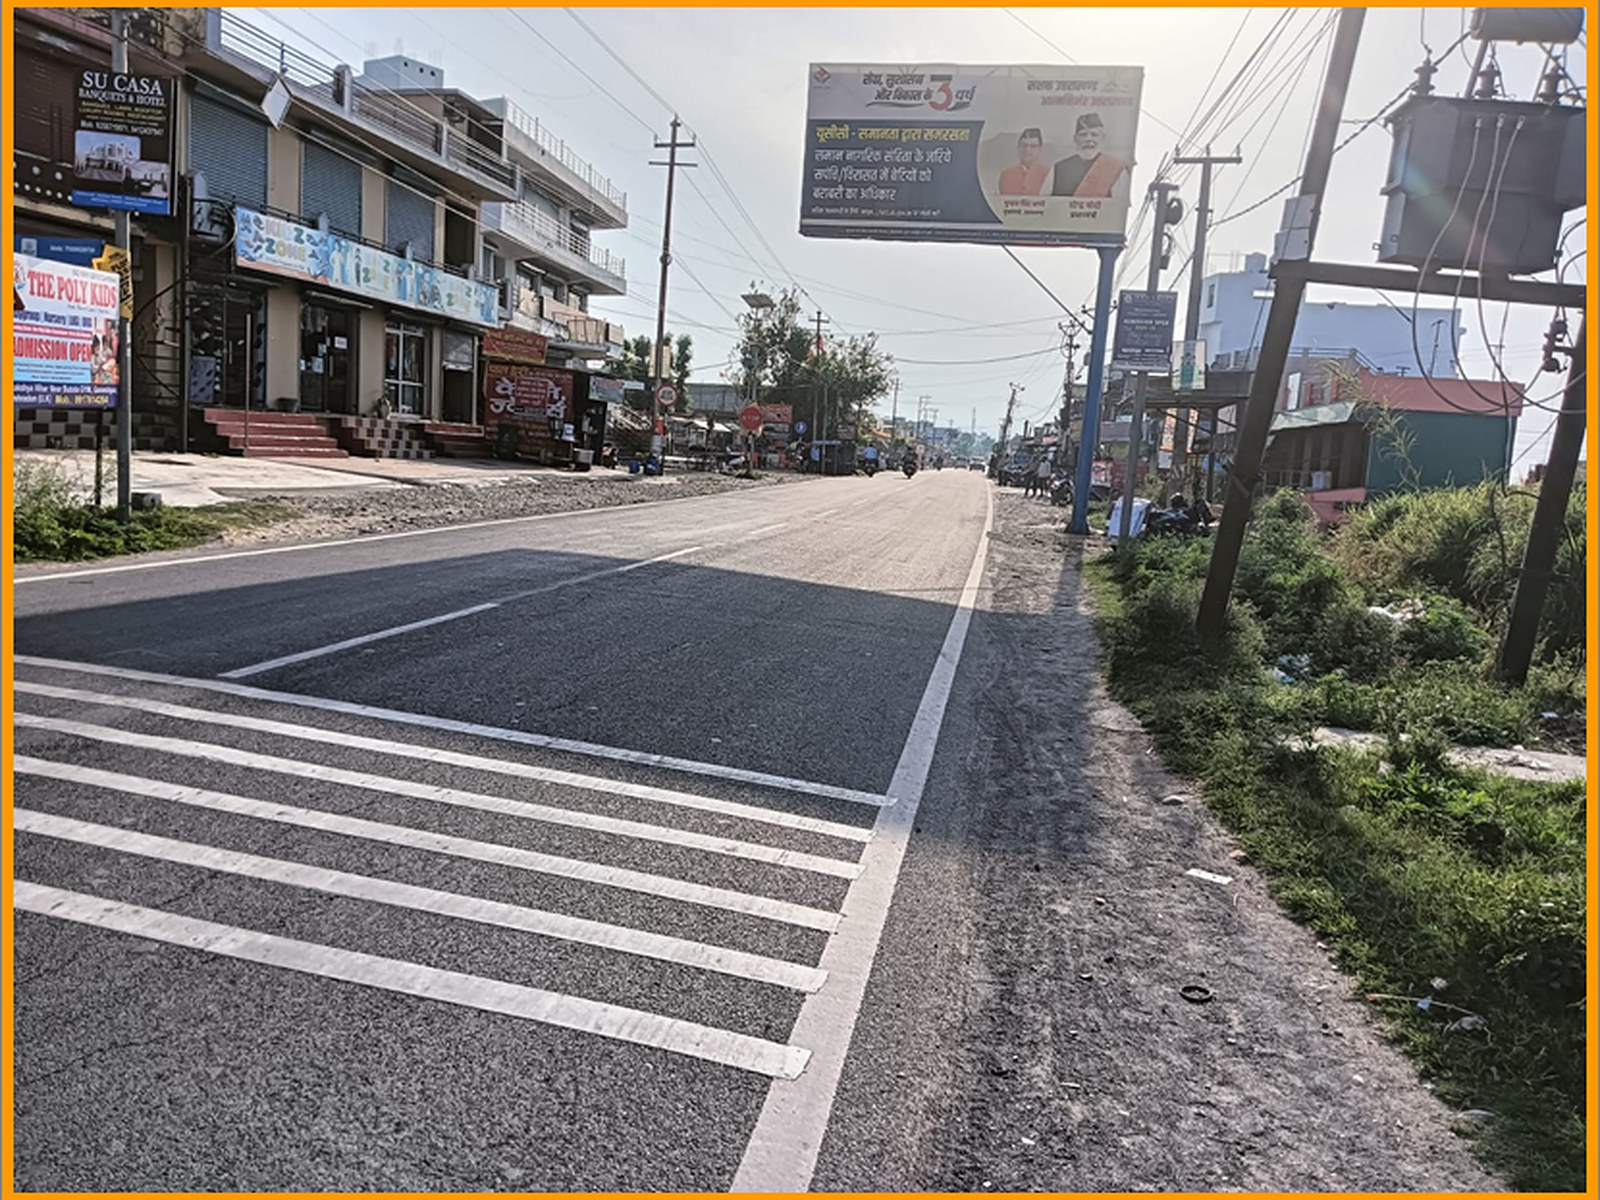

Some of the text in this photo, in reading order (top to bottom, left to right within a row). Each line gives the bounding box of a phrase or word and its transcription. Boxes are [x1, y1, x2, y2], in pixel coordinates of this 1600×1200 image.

[83, 70, 163, 96] SU CASA
[886, 73, 925, 88] सुशासन
[79, 87, 167, 107] BANQUETS & HOTEL
[874, 74, 976, 111] और विकास के 3 वर्ष
[815, 124, 849, 143] यूसीसी
[858, 127, 899, 141] समानता
[901, 127, 923, 143] द्वारा
[923, 128, 970, 142] समरसता
[814, 149, 844, 163] समान
[845, 147, 882, 163] नागरिक
[913, 148, 924, 163] के
[879, 166, 890, 182] में
[918, 167, 932, 182] को
[812, 184, 897, 201] बराबरी का अधिकार
[265, 237, 306, 262] ZONE
[27, 269, 55, 300] THE
[57, 276, 88, 305] POLY
[90, 282, 117, 309] KIDS
[69, 341, 92, 363] OPEN
